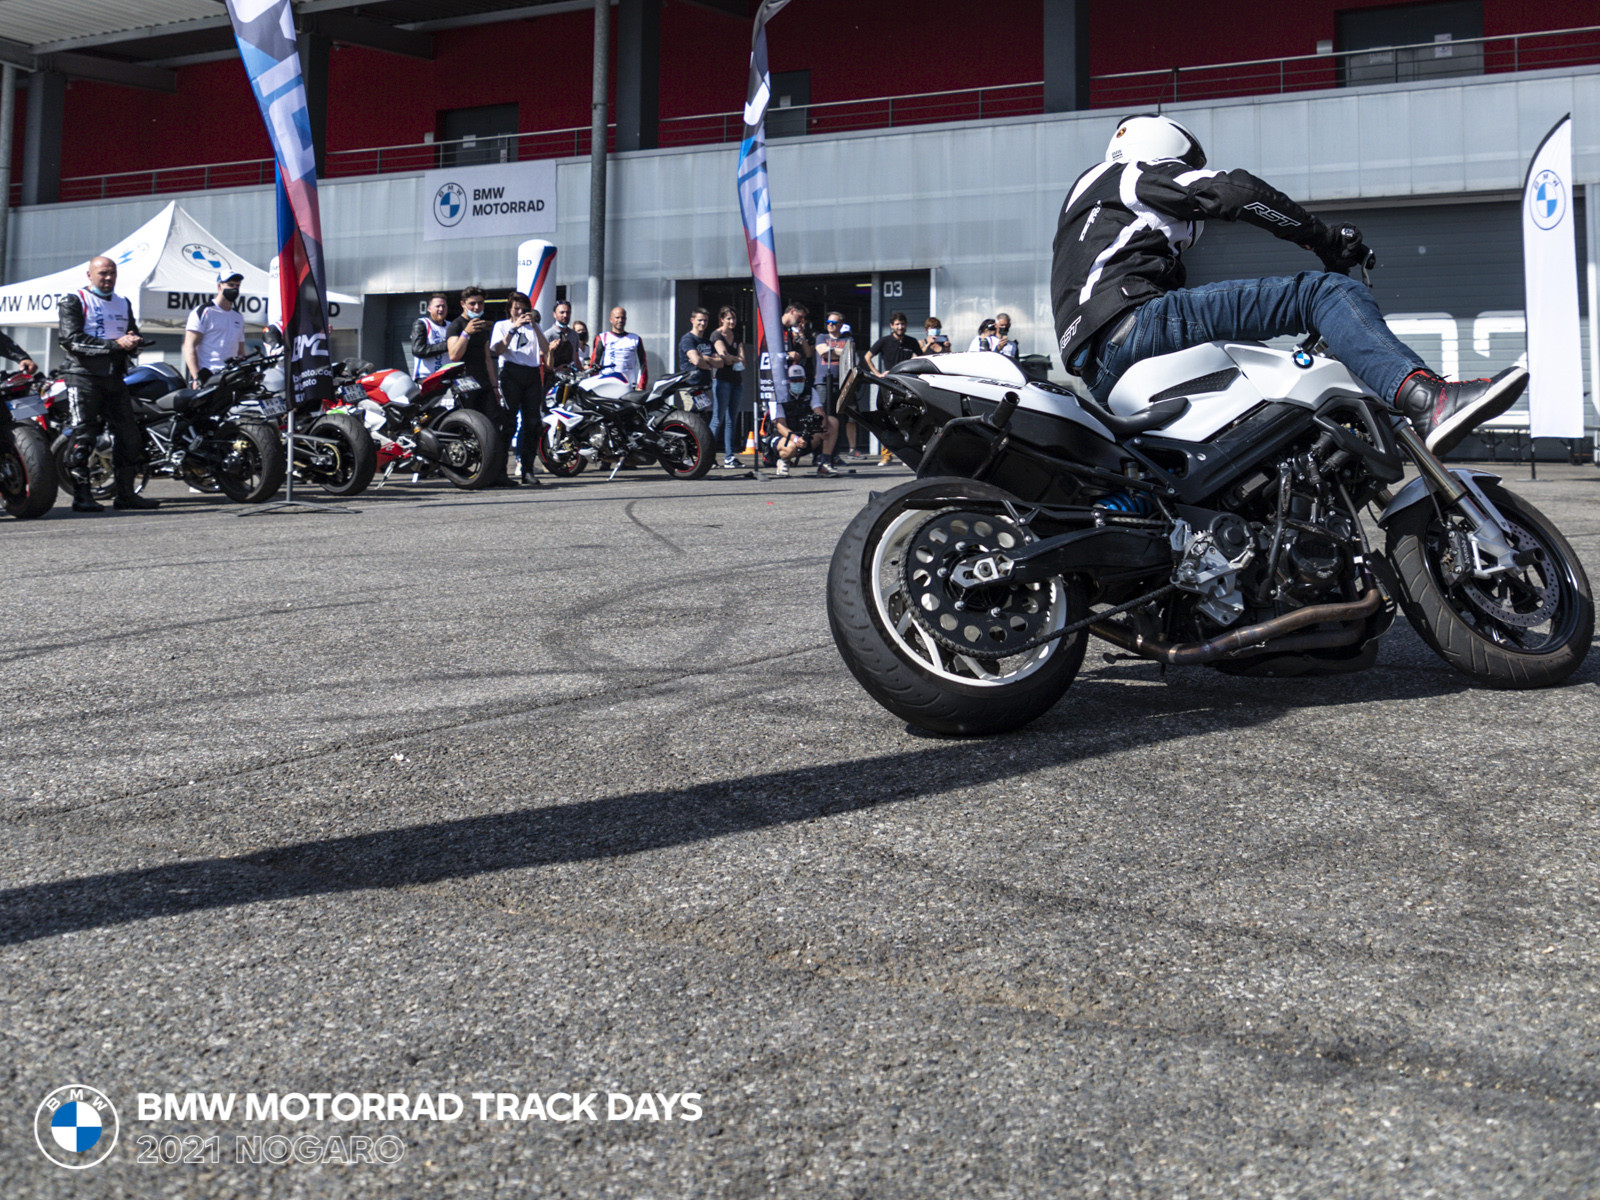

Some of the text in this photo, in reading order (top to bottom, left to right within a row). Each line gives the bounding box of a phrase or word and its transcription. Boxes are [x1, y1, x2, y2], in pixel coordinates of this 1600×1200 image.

[438, 184, 463, 198] BMW
[473, 187, 505, 201] BMW
[472, 199, 545, 216] MOTORRAD
[1243, 201, 1302, 227] RST
[883, 281, 903, 297] 03
[1059, 315, 1082, 354] RST
